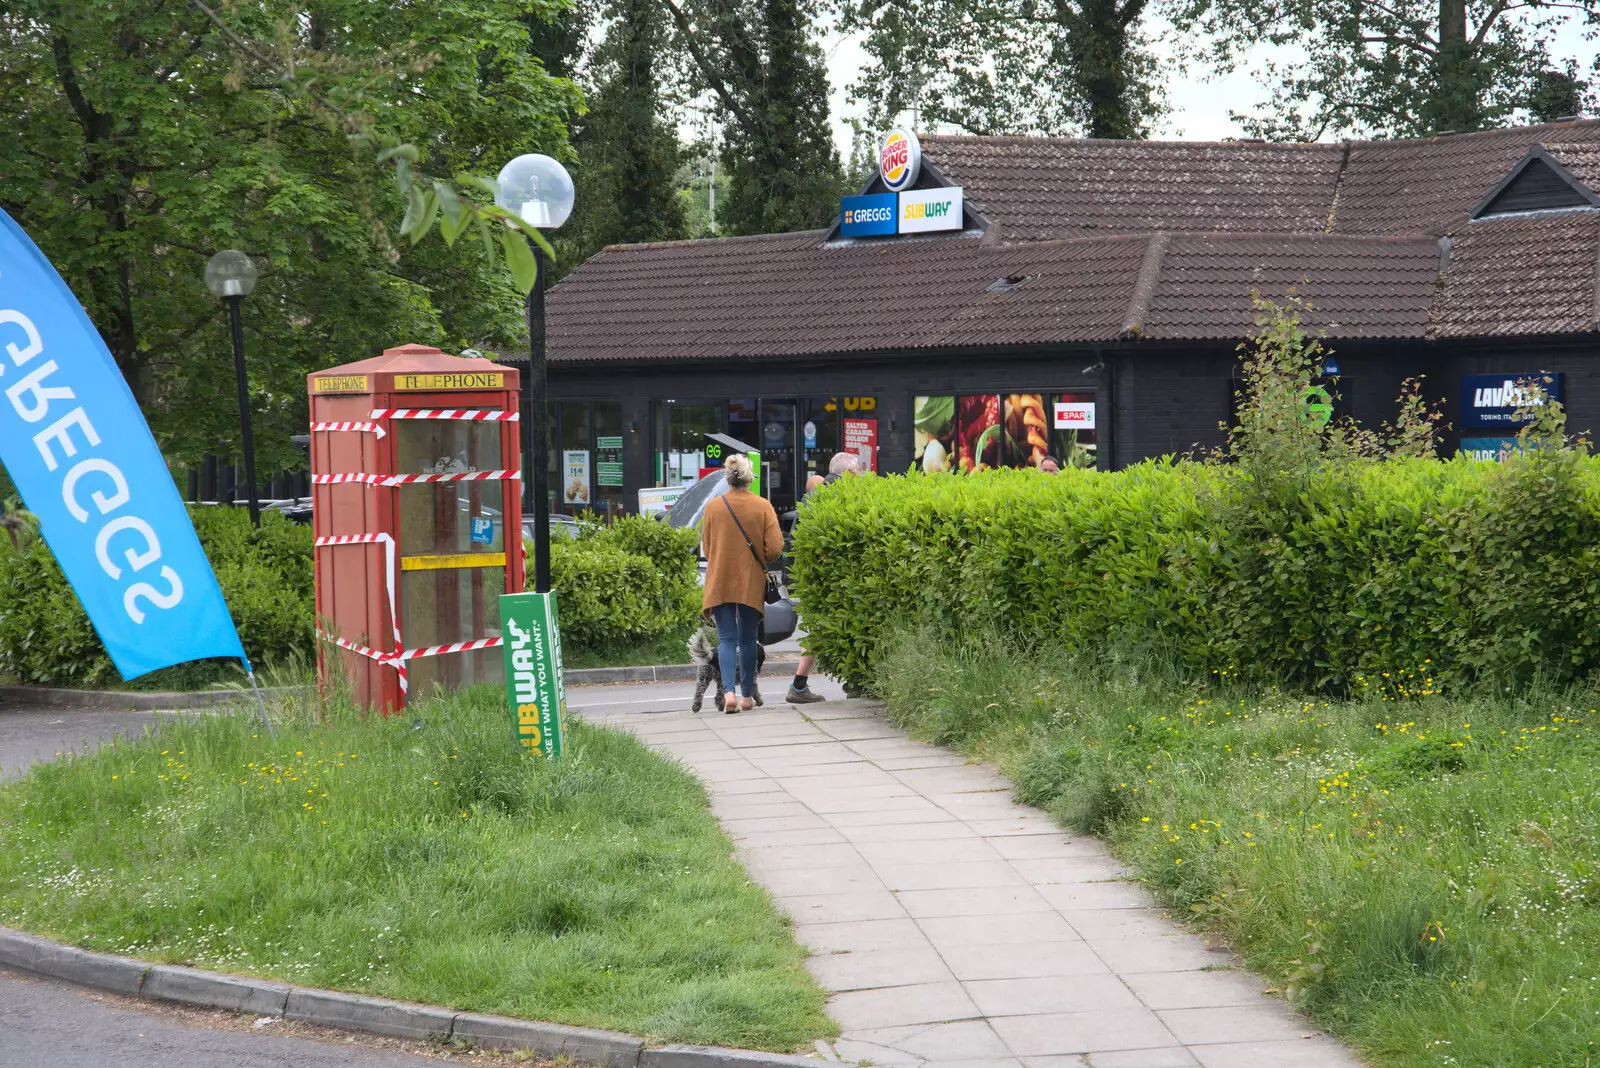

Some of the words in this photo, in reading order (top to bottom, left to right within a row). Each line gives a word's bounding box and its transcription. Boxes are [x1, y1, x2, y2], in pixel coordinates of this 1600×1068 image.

[882, 140, 907, 157] BURGER
[882, 149, 908, 175] KING
[854, 207, 892, 223] GREGGS
[903, 201, 952, 219] SUBWAY
[317, 376, 365, 391] TELEPHONE
[403, 373, 498, 389] TELEPHONE
[1063, 412, 1085, 420] SPAR
[536, 662, 547, 687] YOU
[540, 689, 551, 724] WHAT
[543, 726, 552, 737] IT
